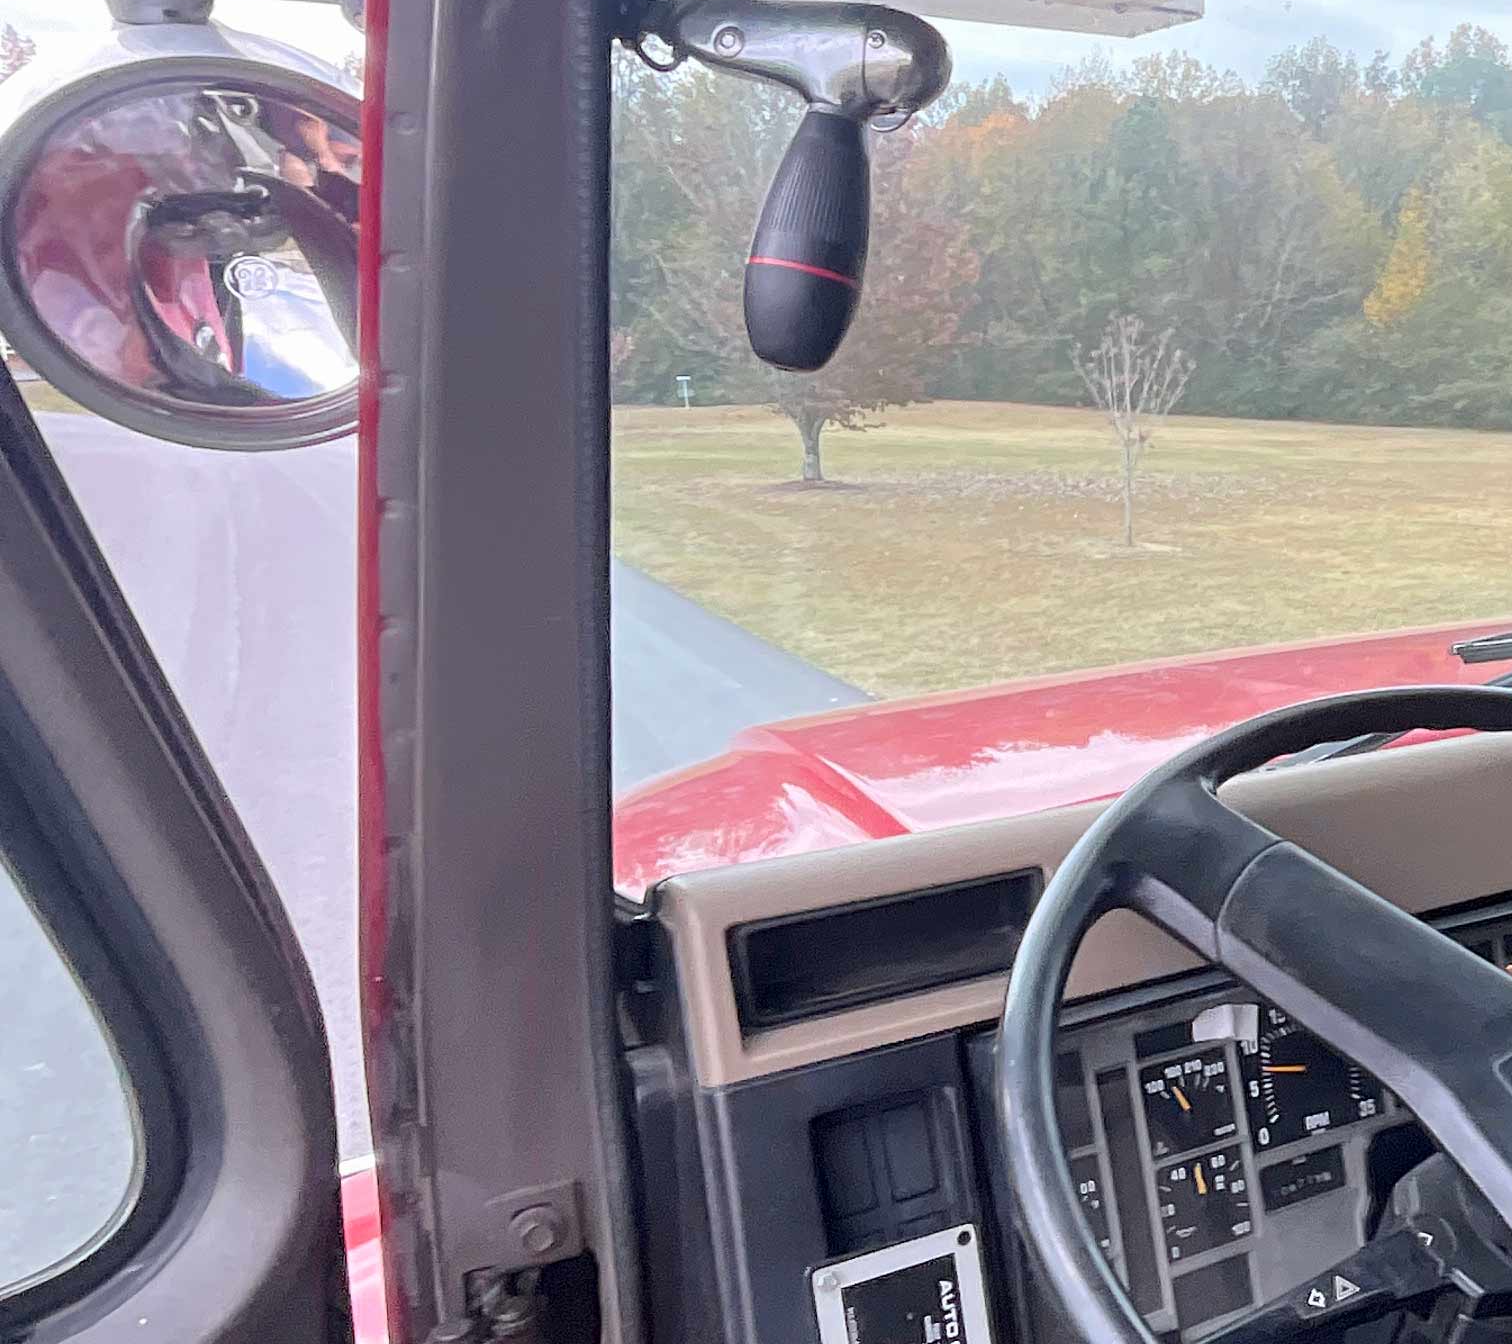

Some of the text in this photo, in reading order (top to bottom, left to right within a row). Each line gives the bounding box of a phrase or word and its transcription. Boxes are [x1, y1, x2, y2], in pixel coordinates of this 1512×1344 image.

[1248, 1080, 1260, 1098] 5
[1257, 1127, 1271, 1146] 0
[939, 1280, 959, 1337] AUTO
